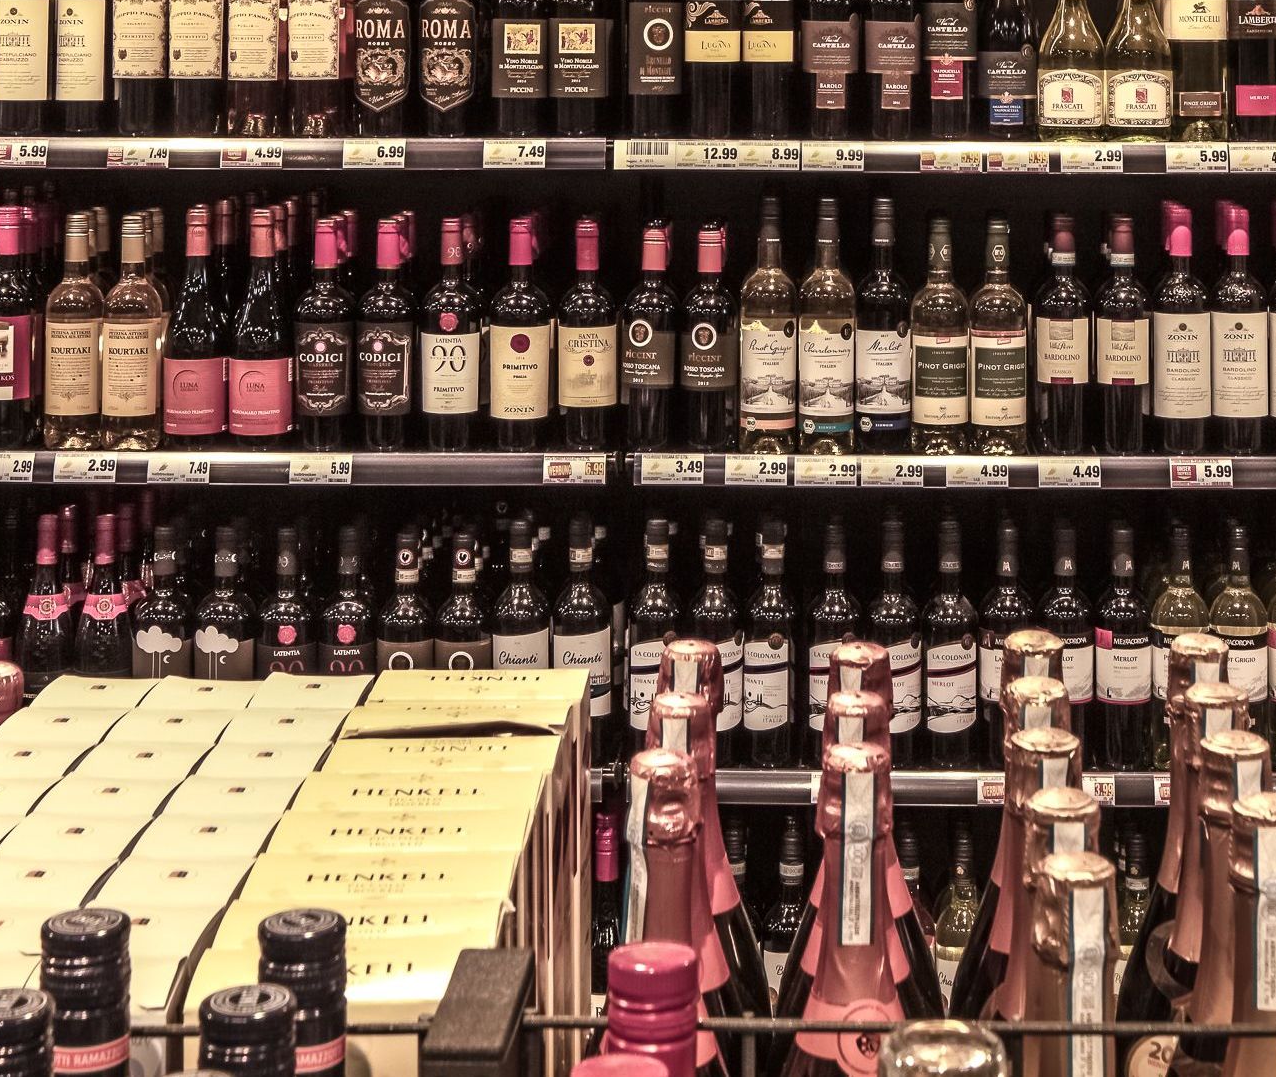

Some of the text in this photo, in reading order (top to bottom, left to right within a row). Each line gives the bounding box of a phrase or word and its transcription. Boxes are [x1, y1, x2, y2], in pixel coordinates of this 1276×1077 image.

[1238, 15, 1276, 25] LAMBERTI
[356, 21, 405, 38] ROMA
[422, 21, 471, 38] ROMA
[19, 146, 46, 157] 5.99
[255, 147, 282, 158] 4.99
[377, 146, 404, 157] 6.99
[518, 146, 545, 157] 7.49
[703, 148, 737, 159] 12.99
[771, 149, 799, 160] 8.99
[836, 150, 863, 161] 9.99
[1095, 151, 1122, 162] 2.99
[1200, 151, 1227, 162] 5.99
[804, 341, 851, 356] Chardonnay
[868, 339, 902, 352] Merlot
[918, 362, 940, 370] PINOT
[88, 461, 115, 472] 2.99
[675, 462, 703, 473] 3.49
[759, 463, 786, 474] 2.99
[896, 465, 922, 477] 2.99
[981, 465, 1007, 476] 4.99
[1073, 467, 1100, 477] 4.49
[1204, 466, 1231, 477] 5.99
